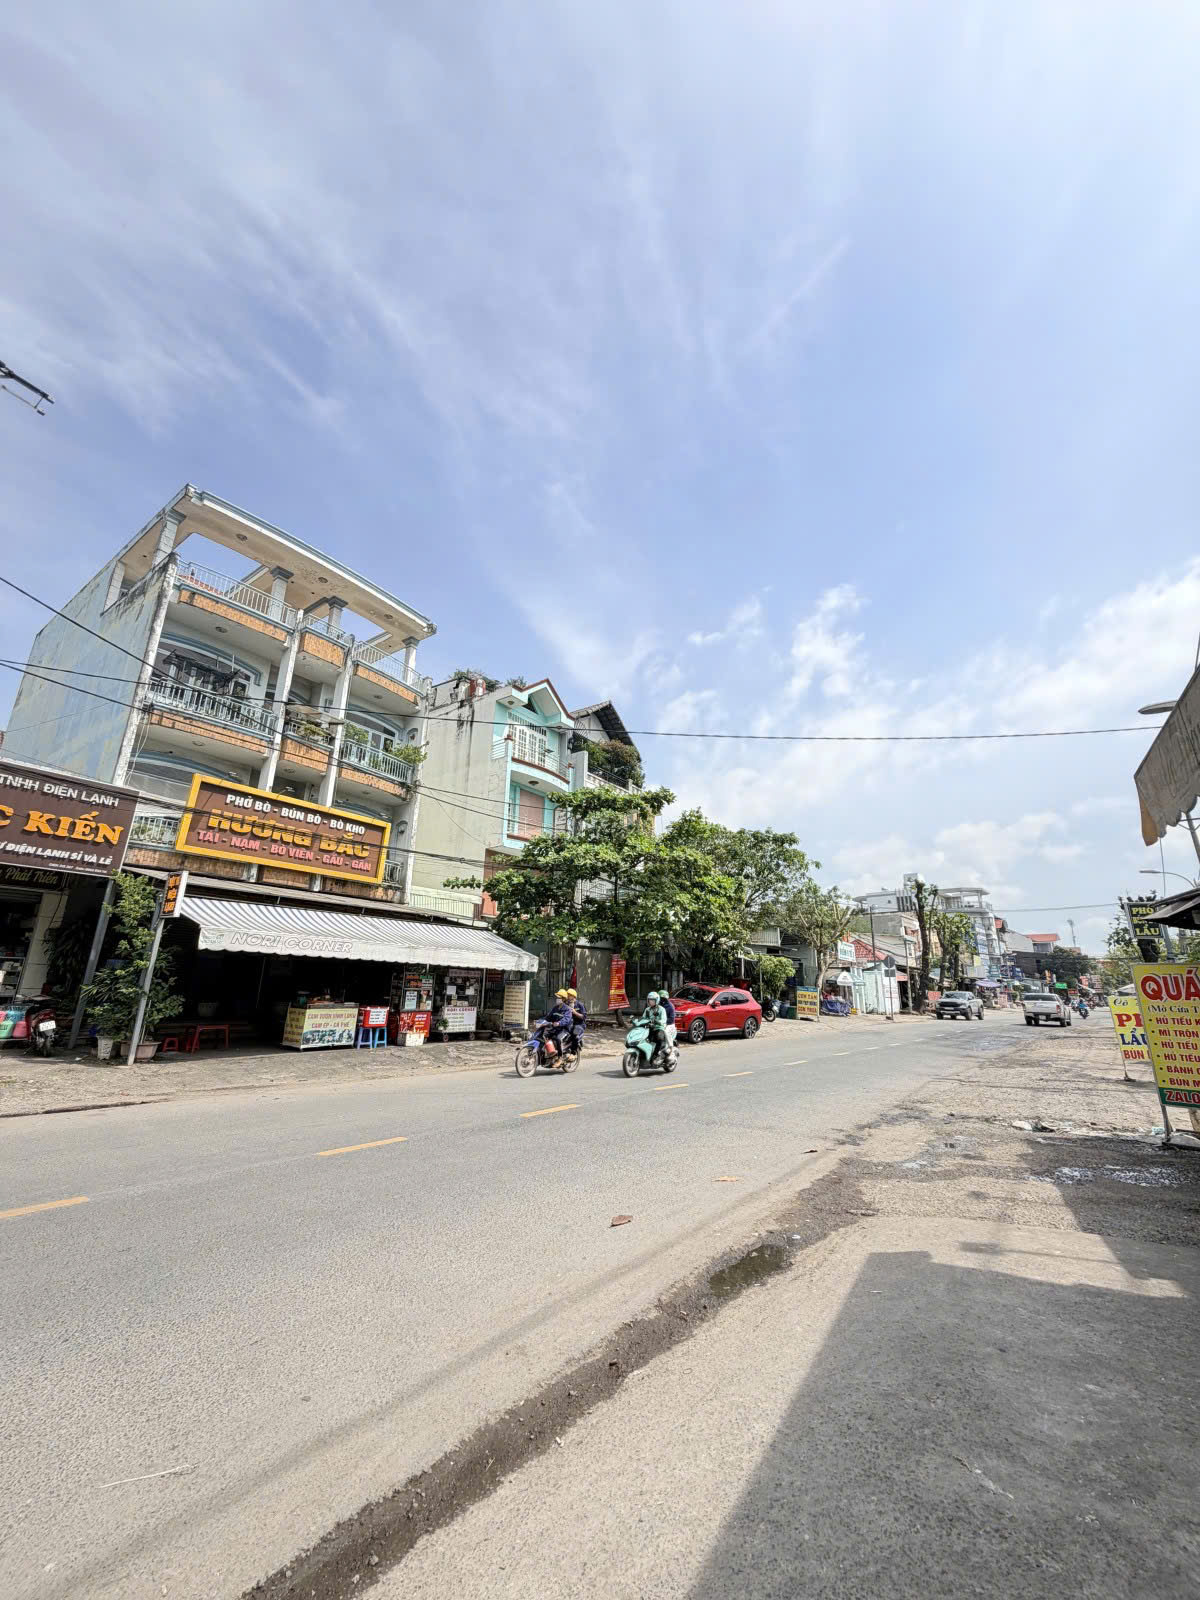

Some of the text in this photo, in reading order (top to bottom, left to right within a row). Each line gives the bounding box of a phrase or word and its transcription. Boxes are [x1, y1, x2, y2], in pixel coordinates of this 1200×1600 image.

[0, 773, 119, 807] TNHH ĐIỆN LẠNH
[226, 793, 254, 809] PHỞ
[254, 801, 272, 813] BÒ
[281, 807, 305, 821] BÚN
[306, 813, 322, 825] BÒ
[329, 818, 344, 830] BÒ
[345, 822, 366, 835] KHO
[24, 811, 124, 845] KIẾN
[208, 809, 370, 858] HƯƠNG BẮC
[6, 843, 37, 854] ĐIỆN
[36, 848, 70, 859] LẠNH
[84, 853, 97, 863] VÀ
[230, 836, 261, 850] NẠM
[271, 844, 286, 855] BÒ
[288, 846, 313, 860] VIÊN
[231, 932, 282, 948] NORI
[283, 937, 353, 953] CORNER
[1123, 1047, 1145, 1060] BÚN
[1166, 1064, 1194, 1075] BÁNH
[1169, 1076, 1190, 1087] BÚN
[1165, 1090, 1200, 1105] ZALO
